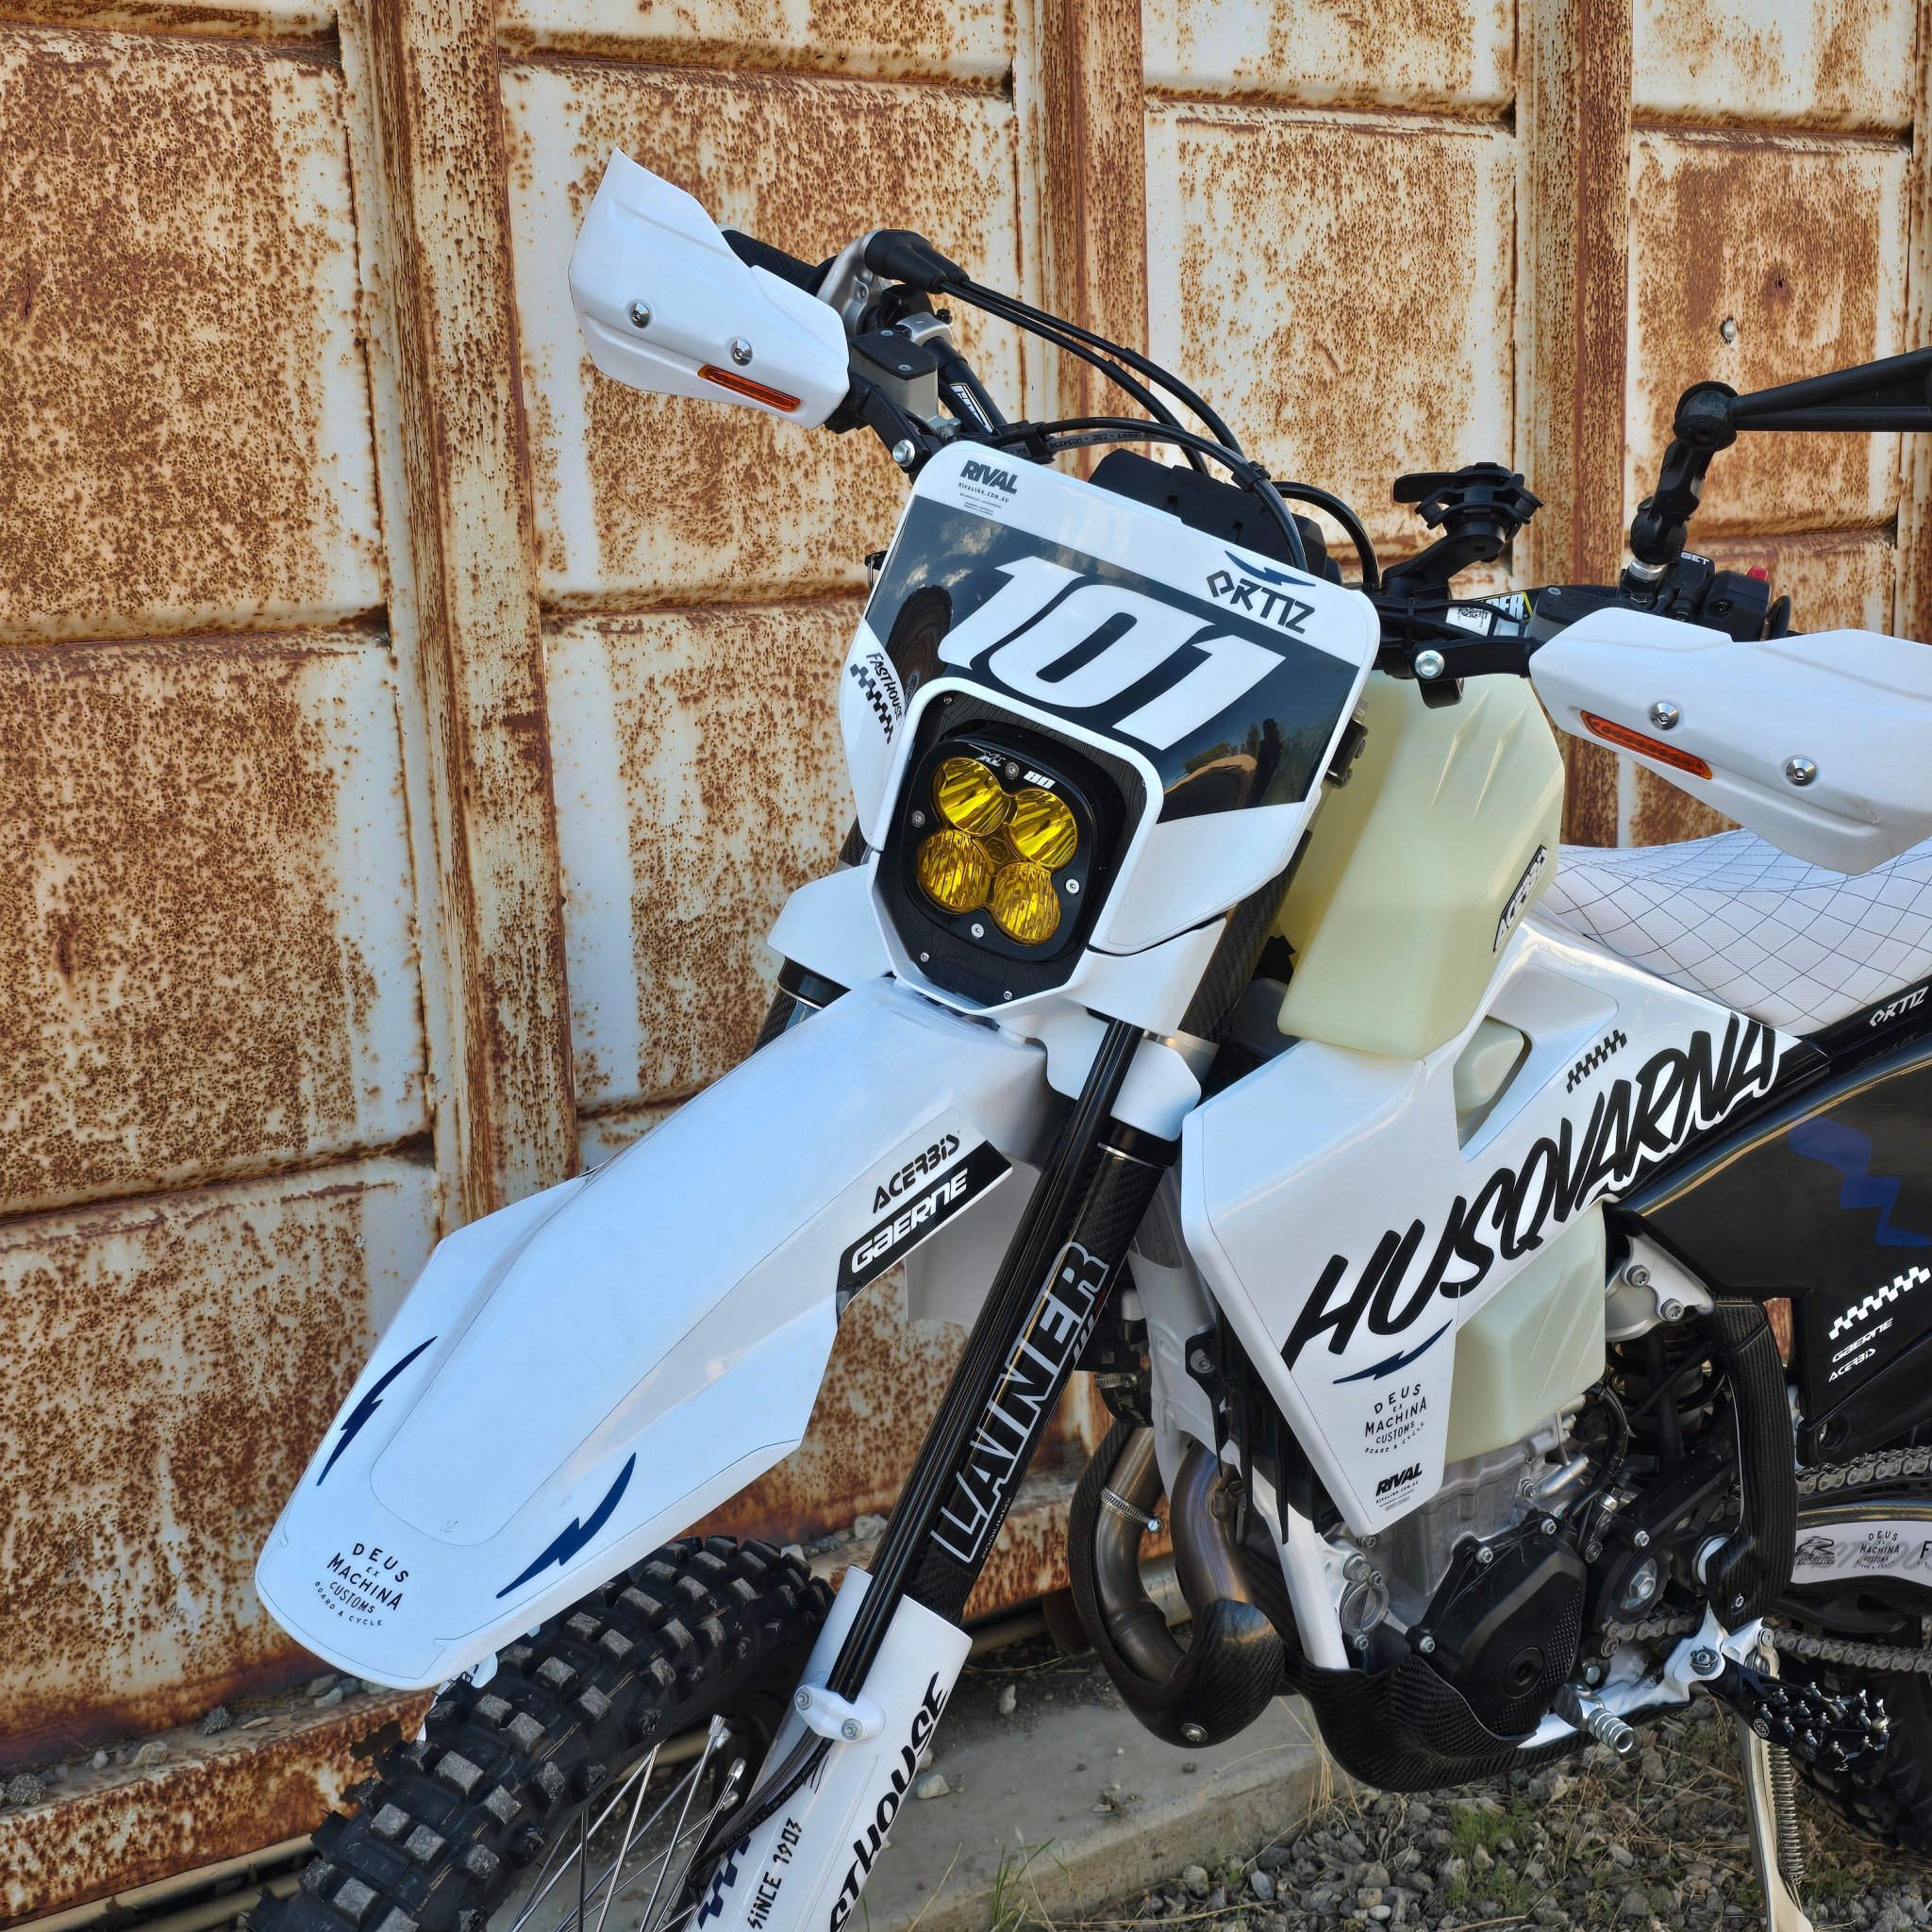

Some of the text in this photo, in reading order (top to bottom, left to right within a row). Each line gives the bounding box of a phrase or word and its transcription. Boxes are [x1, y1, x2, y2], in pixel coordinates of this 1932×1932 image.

[959, 459, 1018, 495] RIVAL
[1680, 551, 1709, 565] GET
[1206, 570, 1316, 635] ORTIZ
[938, 556, 1287, 751] 101
[866, 652, 903, 722] FASTHOUSE
[1869, 986, 1929, 1027] ORTIZ
[873, 1133, 960, 1214] ACERBIS
[1280, 1011, 1777, 1372] HUSQVARNA
[851, 1167, 968, 1274] GAERNE
[1832, 1317, 1894, 1363] GAERNE
[1828, 1348, 1876, 1383] ACERBIS
[930, 1241, 1110, 1563] LAINER
[1365, 1396, 1427, 1438] MACHINA
[1374, 1383, 1422, 1415] DEUS
[1375, 1421, 1415, 1444] CUSTOMS
[1375, 1461, 1423, 1497] RIVAL
[1858, 1543, 1900, 1555] MACHINA
[1868, 1530, 1898, 1541] DEUS
[326, 1552, 404, 1611] MACHINA
[352, 1542, 409, 1583] DEUS
[365, 1566, 380, 1578] EX
[314, 1581, 336, 1610] BOARD
[348, 1615, 383, 1626] CYCLE
[329, 1581, 375, 1614] CUSTOMS
[747, 1817, 803, 1929] SINCE 1903
